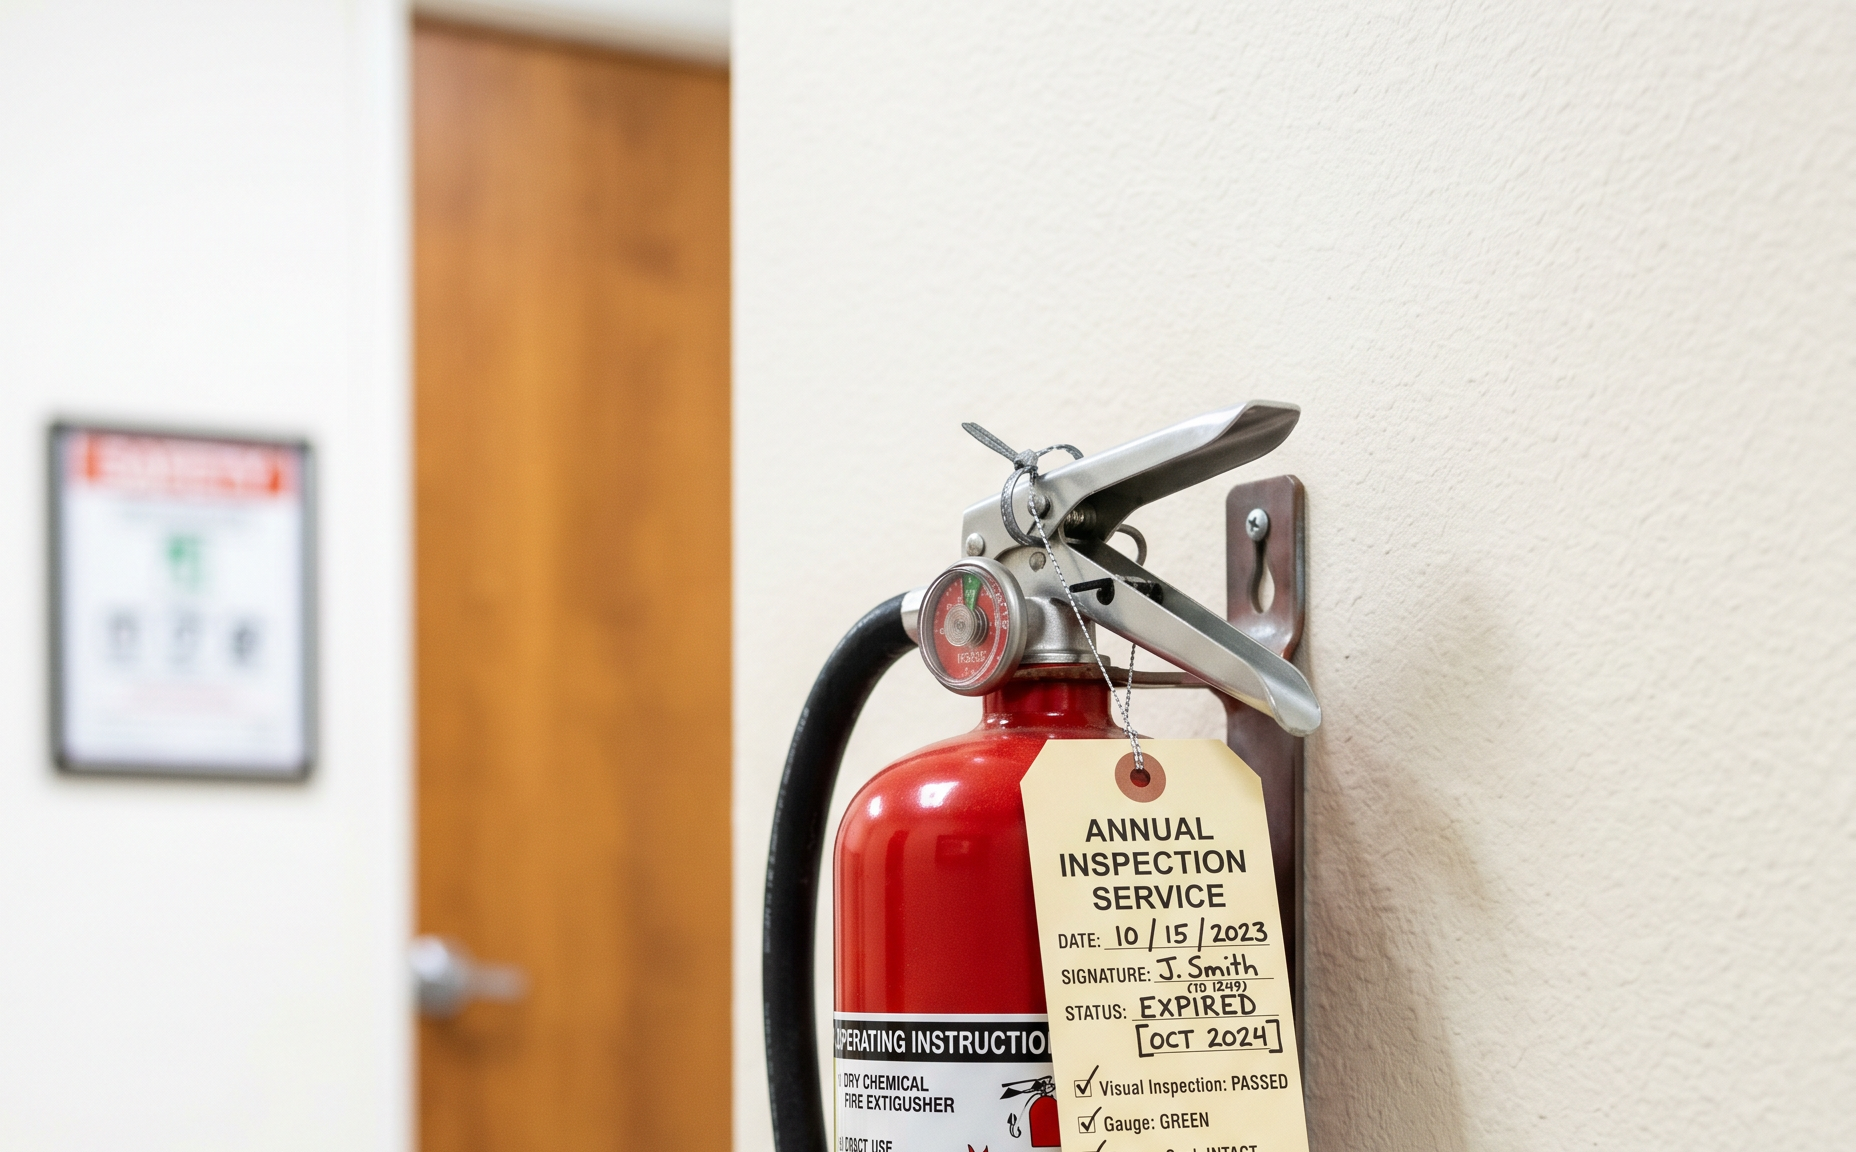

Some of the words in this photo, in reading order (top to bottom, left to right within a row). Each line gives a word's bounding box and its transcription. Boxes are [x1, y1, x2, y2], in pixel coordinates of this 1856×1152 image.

[1086, 817, 1214, 842] ANNUAL
[1060, 850, 1246, 877] INSPECTION
[1093, 884, 1226, 910] SERVICE
[1058, 933, 1100, 948] DATE:
[1062, 967, 1151, 984] SIGNATURE:
[1156, 955, 1183, 981] J.
[1187, 953, 1260, 979] Smith
[1213, 980, 1247, 993] 1249)
[1065, 1004, 1126, 1021] STATUS:
[1139, 994, 1257, 1018] EXPIRED
[912, 1030, 1053, 1055] INSTRUCTIO
[844, 1073, 860, 1088] DRY
[863, 1074, 930, 1092] CHEMICAL
[1099, 1080, 1144, 1096] Visual
[1149, 1077, 1226, 1097] Inspection:
[1232, 1074, 1288, 1091] PASSED
[845, 1093, 863, 1109] FIRE
[867, 1095, 954, 1113] EXTIGUSHER
[1104, 1116, 1154, 1134] Gauge:
[1160, 1112, 1209, 1129] GREEN
